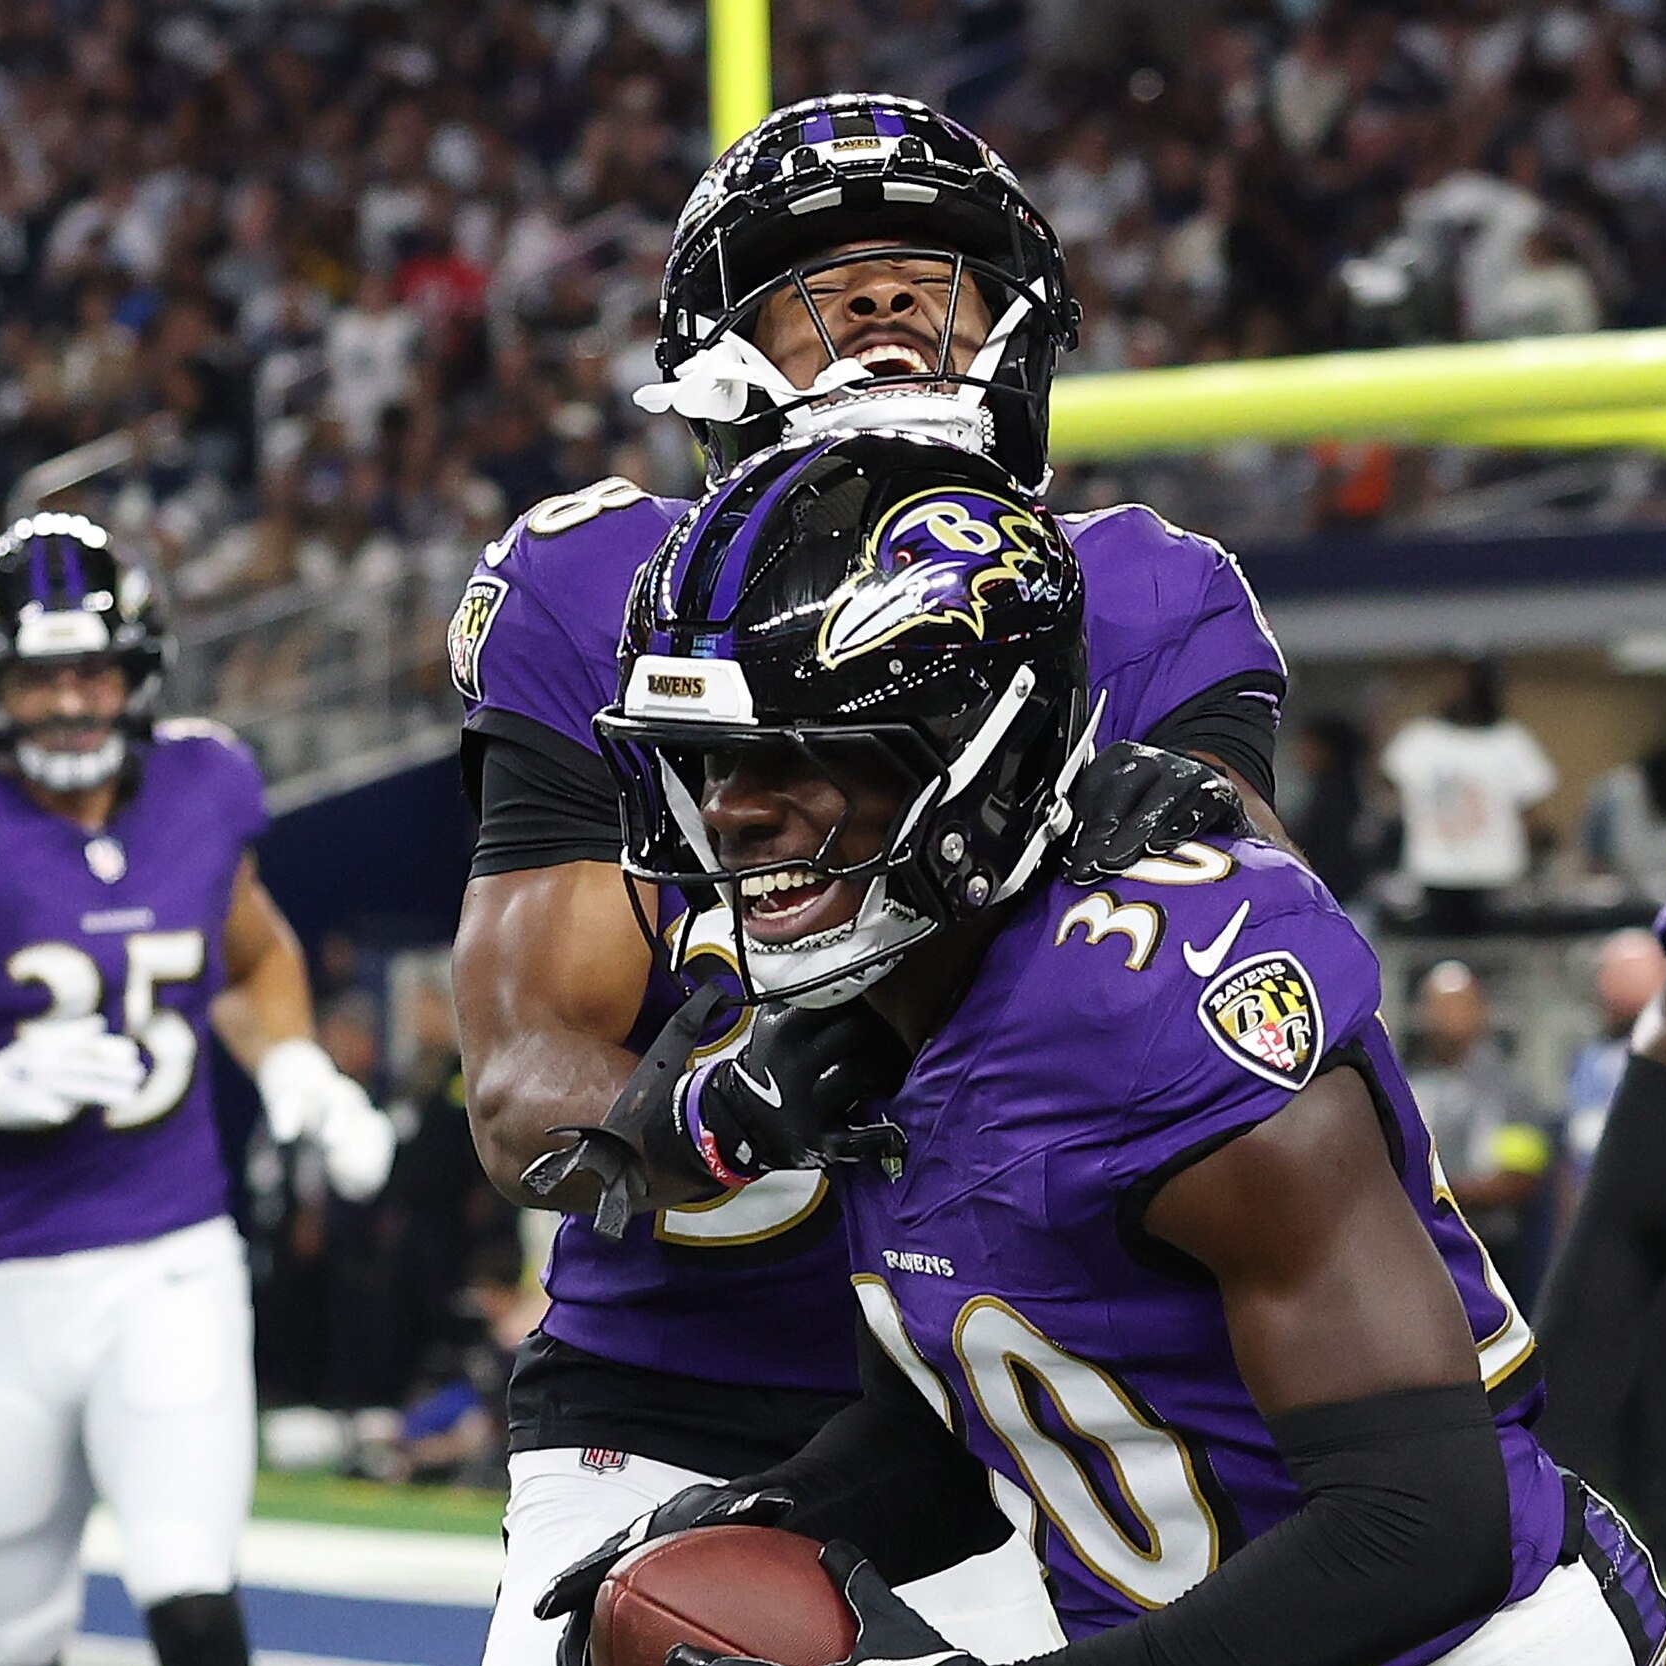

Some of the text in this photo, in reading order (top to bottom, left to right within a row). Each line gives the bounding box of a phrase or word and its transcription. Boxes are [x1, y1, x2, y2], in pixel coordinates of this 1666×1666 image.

[831, 137, 881, 152] RAVENS
[527, 476, 645, 533] 8
[647, 674, 707, 699] RAVENS
[1209, 961, 1287, 1011] RAVENS
[882, 1250, 955, 1278] RAVENS
[584, 1447, 622, 1466] NFL
